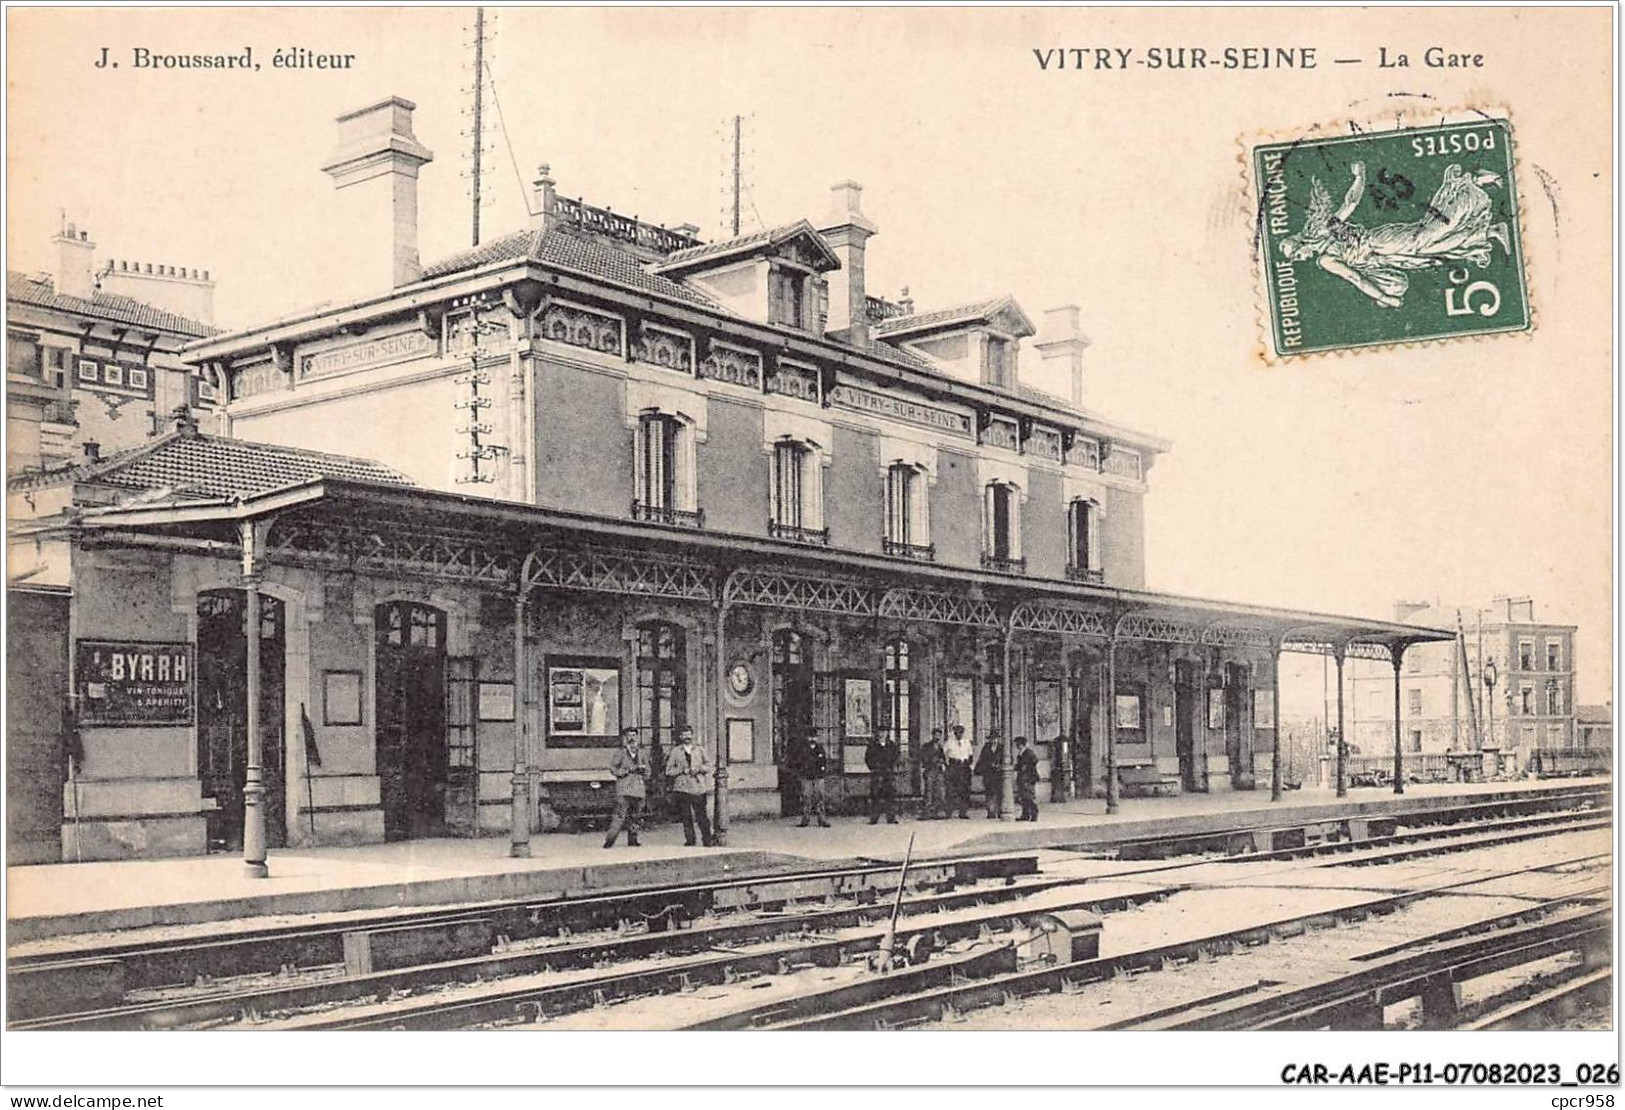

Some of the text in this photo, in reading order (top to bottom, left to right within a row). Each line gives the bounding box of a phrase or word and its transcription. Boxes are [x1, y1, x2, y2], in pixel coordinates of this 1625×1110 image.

[1411, 130, 1496, 157] POSTES
[1263, 152, 1303, 348] REPUBLIQUE FRANÇAISE
[848, 390, 956, 428] VITRY-SUR-SEINE
[112, 653, 186, 681] BYRRH
[126, 687, 143, 695] VIN
